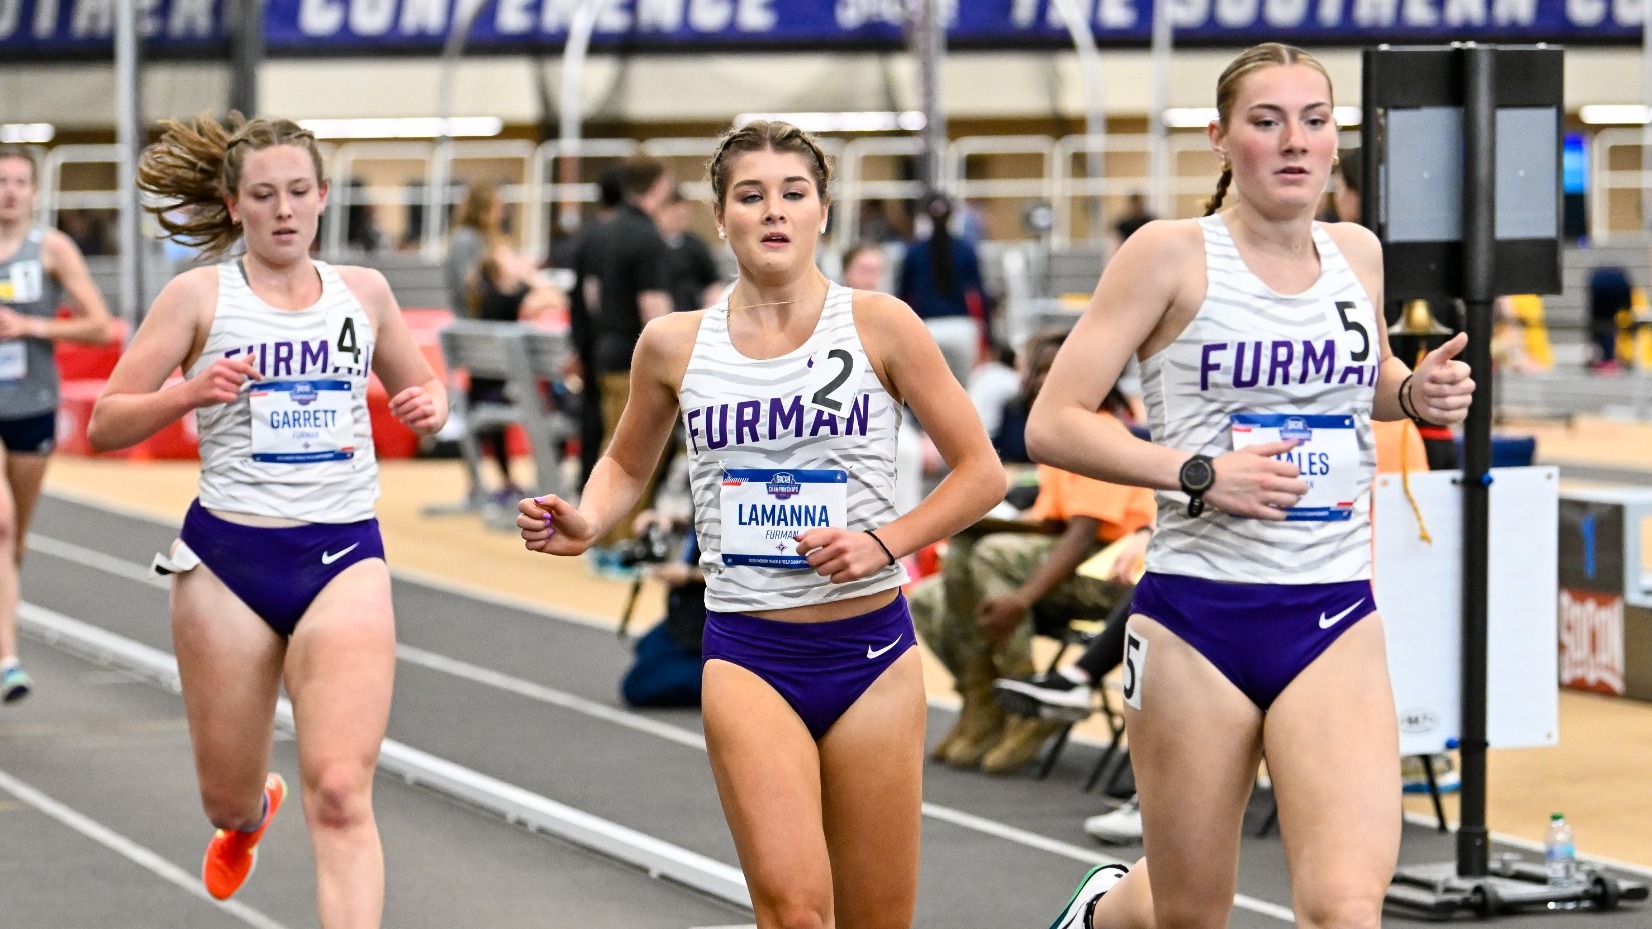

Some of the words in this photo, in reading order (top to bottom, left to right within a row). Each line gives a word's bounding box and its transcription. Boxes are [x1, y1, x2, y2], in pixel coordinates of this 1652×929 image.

[337, 317, 361, 364] 4
[1335, 301, 1369, 362] 5
[811, 349, 854, 412] 2
[270, 409, 337, 429] GARRETT
[687, 393, 870, 455] FURMAN
[738, 503, 830, 528] LAMANNA
[1124, 633, 1141, 700] 5
